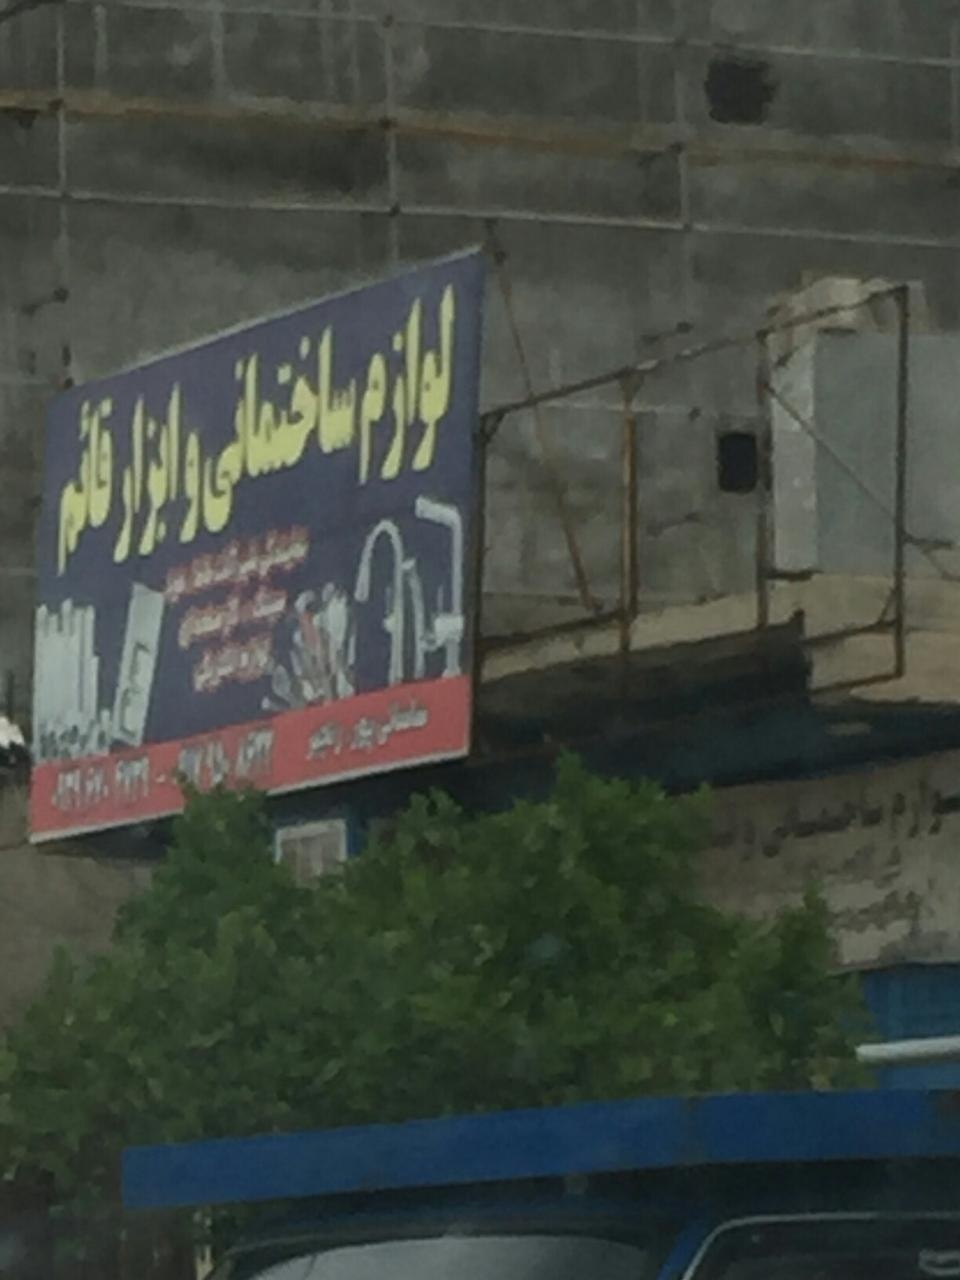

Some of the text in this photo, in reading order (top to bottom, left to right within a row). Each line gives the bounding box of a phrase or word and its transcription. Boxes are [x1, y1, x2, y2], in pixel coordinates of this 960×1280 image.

[113, 381, 181, 564] ابزار
[203, 325, 357, 533] ساختمانی
[356, 283, 455, 487] لوازم
[57, 397, 113, 578] قائم
[178, 431, 201, 544] و
